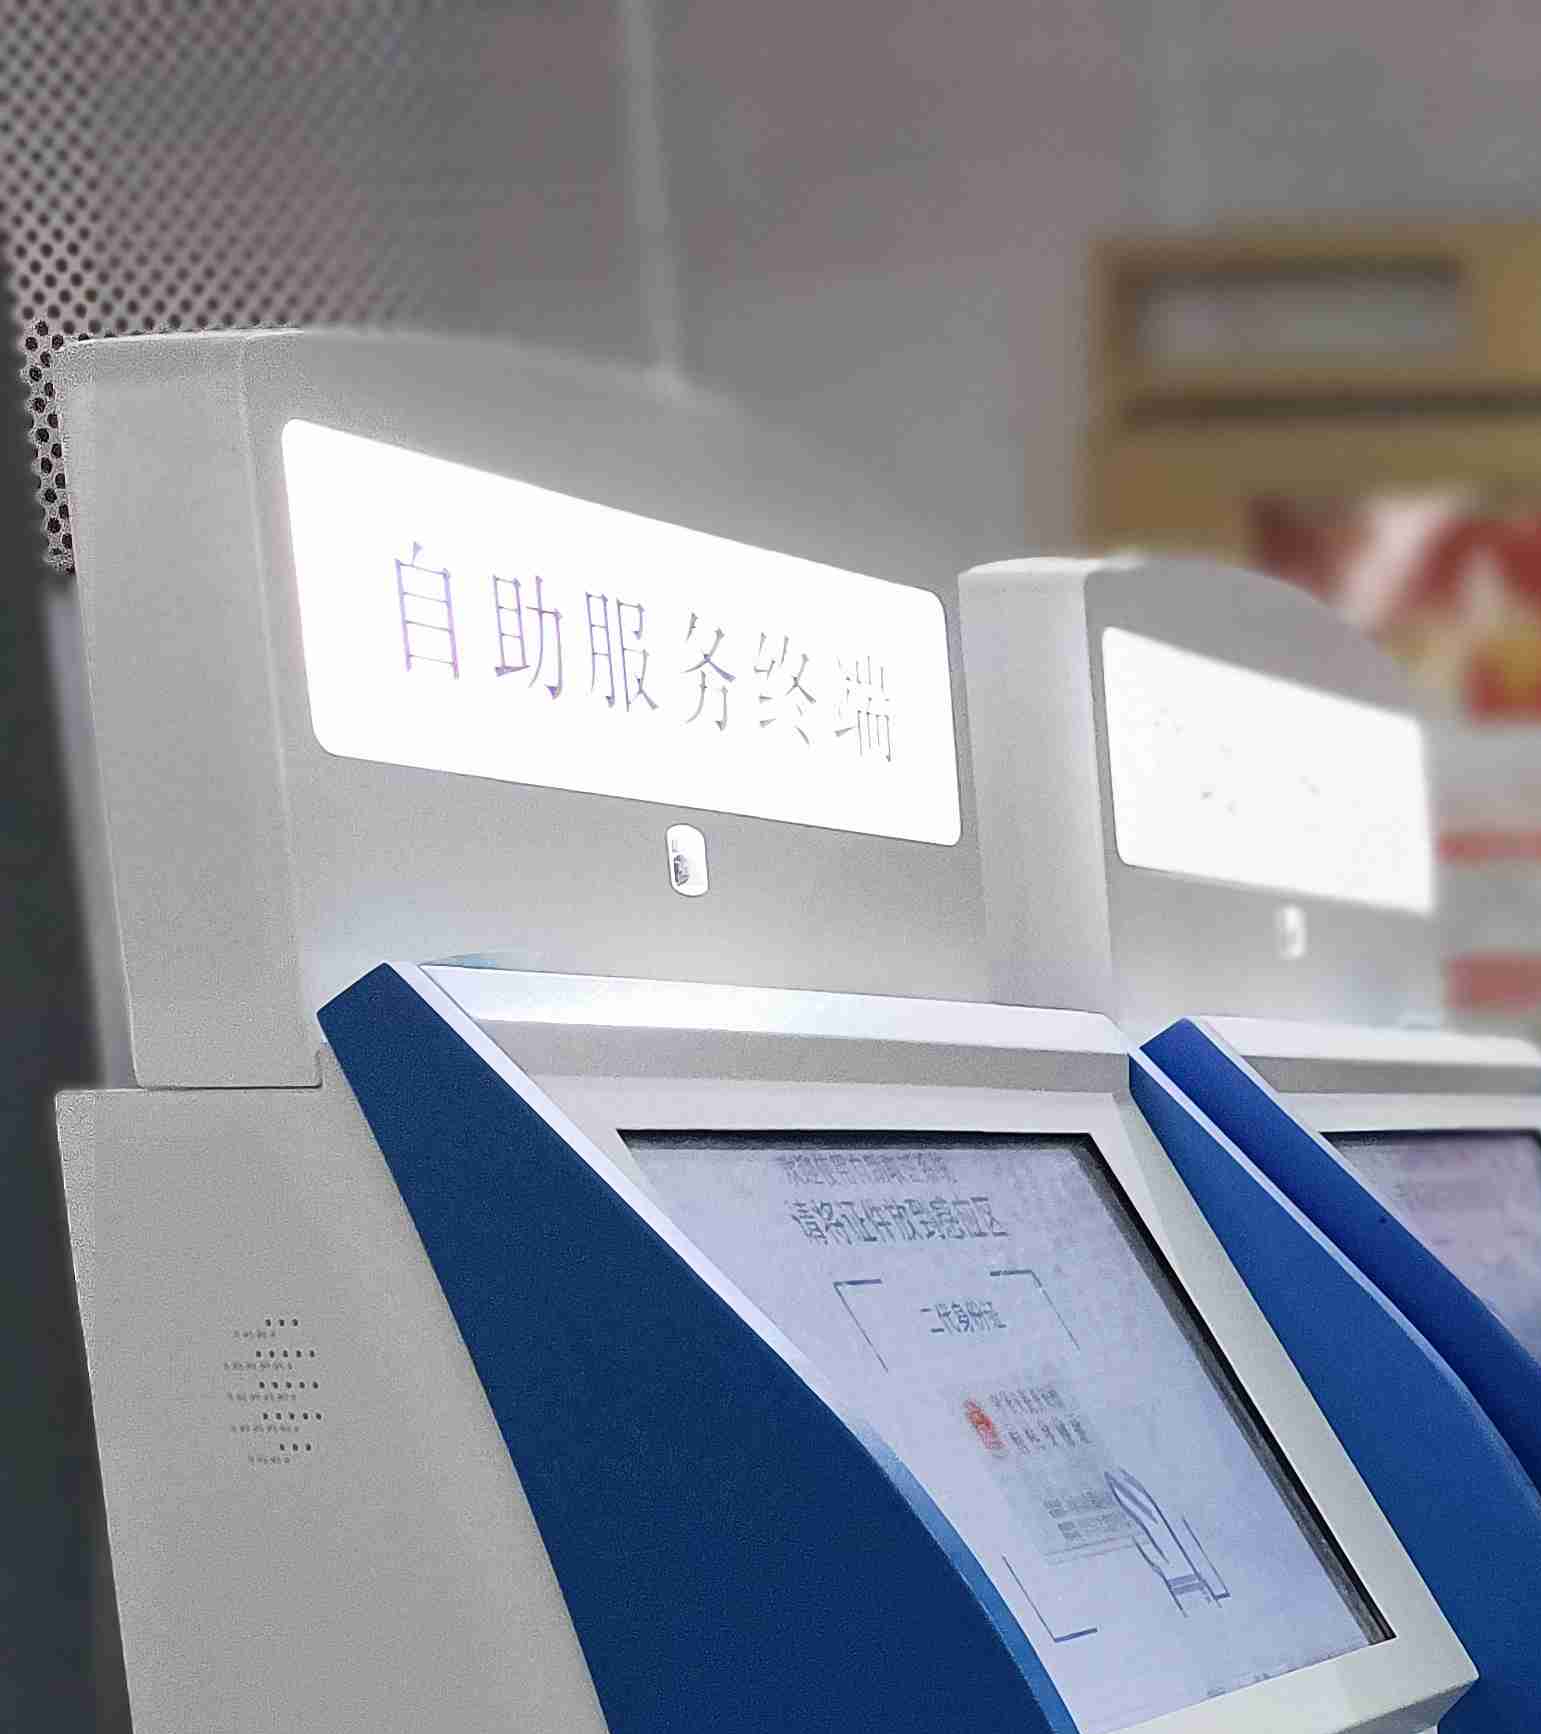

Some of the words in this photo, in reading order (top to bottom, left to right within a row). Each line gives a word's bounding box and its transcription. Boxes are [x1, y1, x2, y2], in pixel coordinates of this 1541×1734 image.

[395, 541, 894, 763] 自助服务终端
